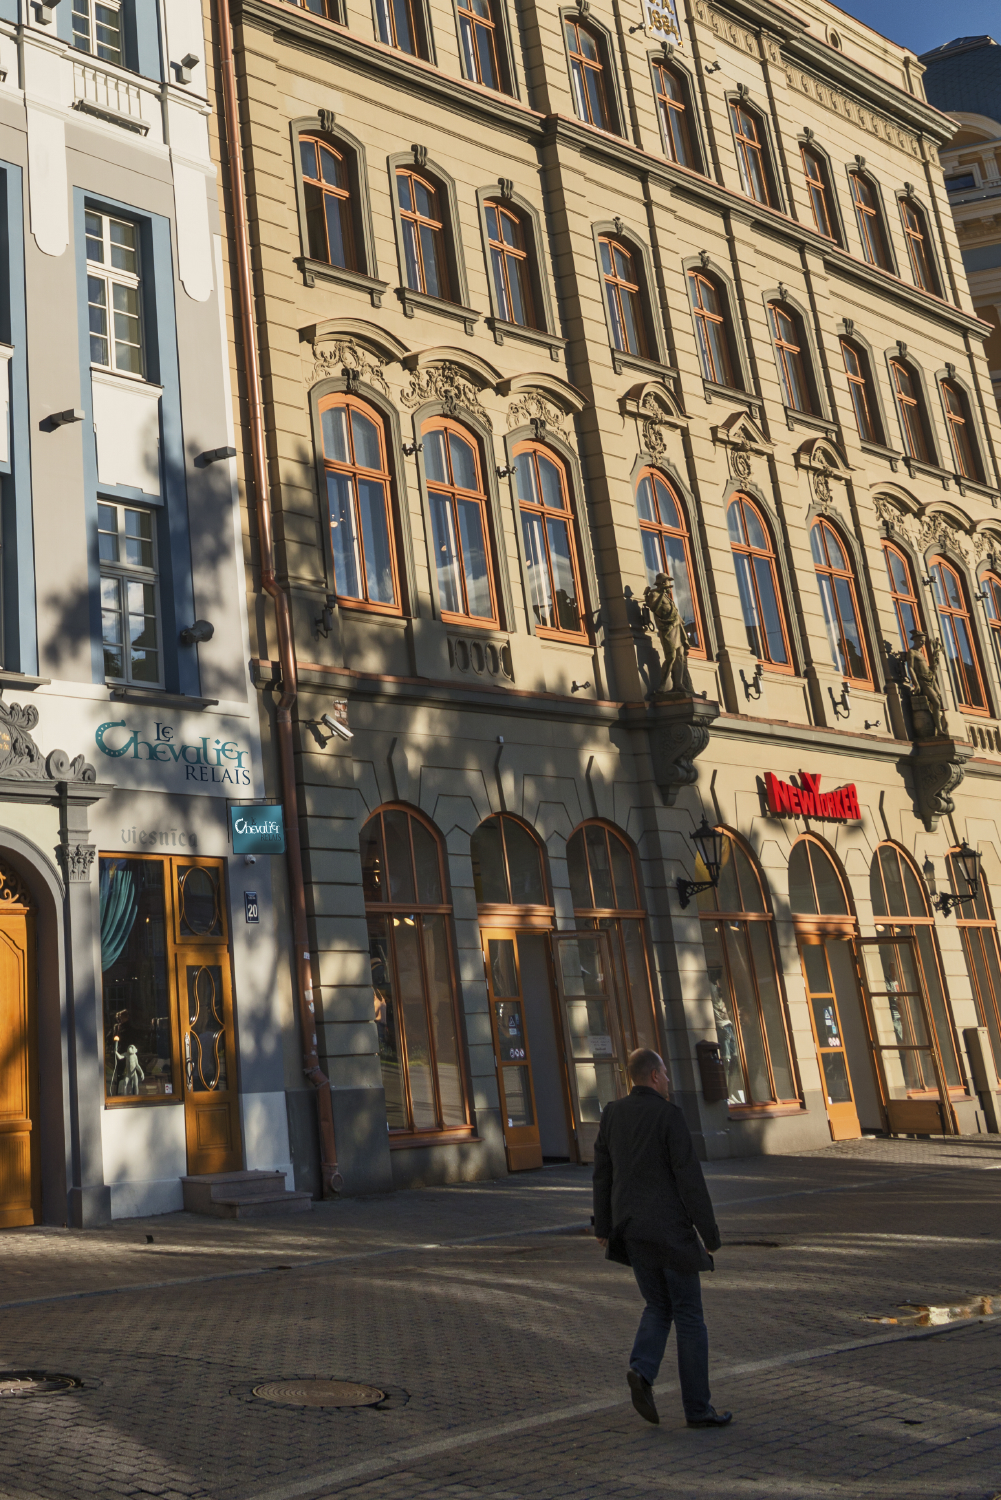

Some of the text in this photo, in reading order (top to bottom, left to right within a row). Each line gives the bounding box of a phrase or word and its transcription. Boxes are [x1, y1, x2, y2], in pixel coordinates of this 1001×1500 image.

[95, 719, 249, 768] Chevalier
[185, 764, 251, 786] RELAIS
[248, 904, 257, 917] 20
